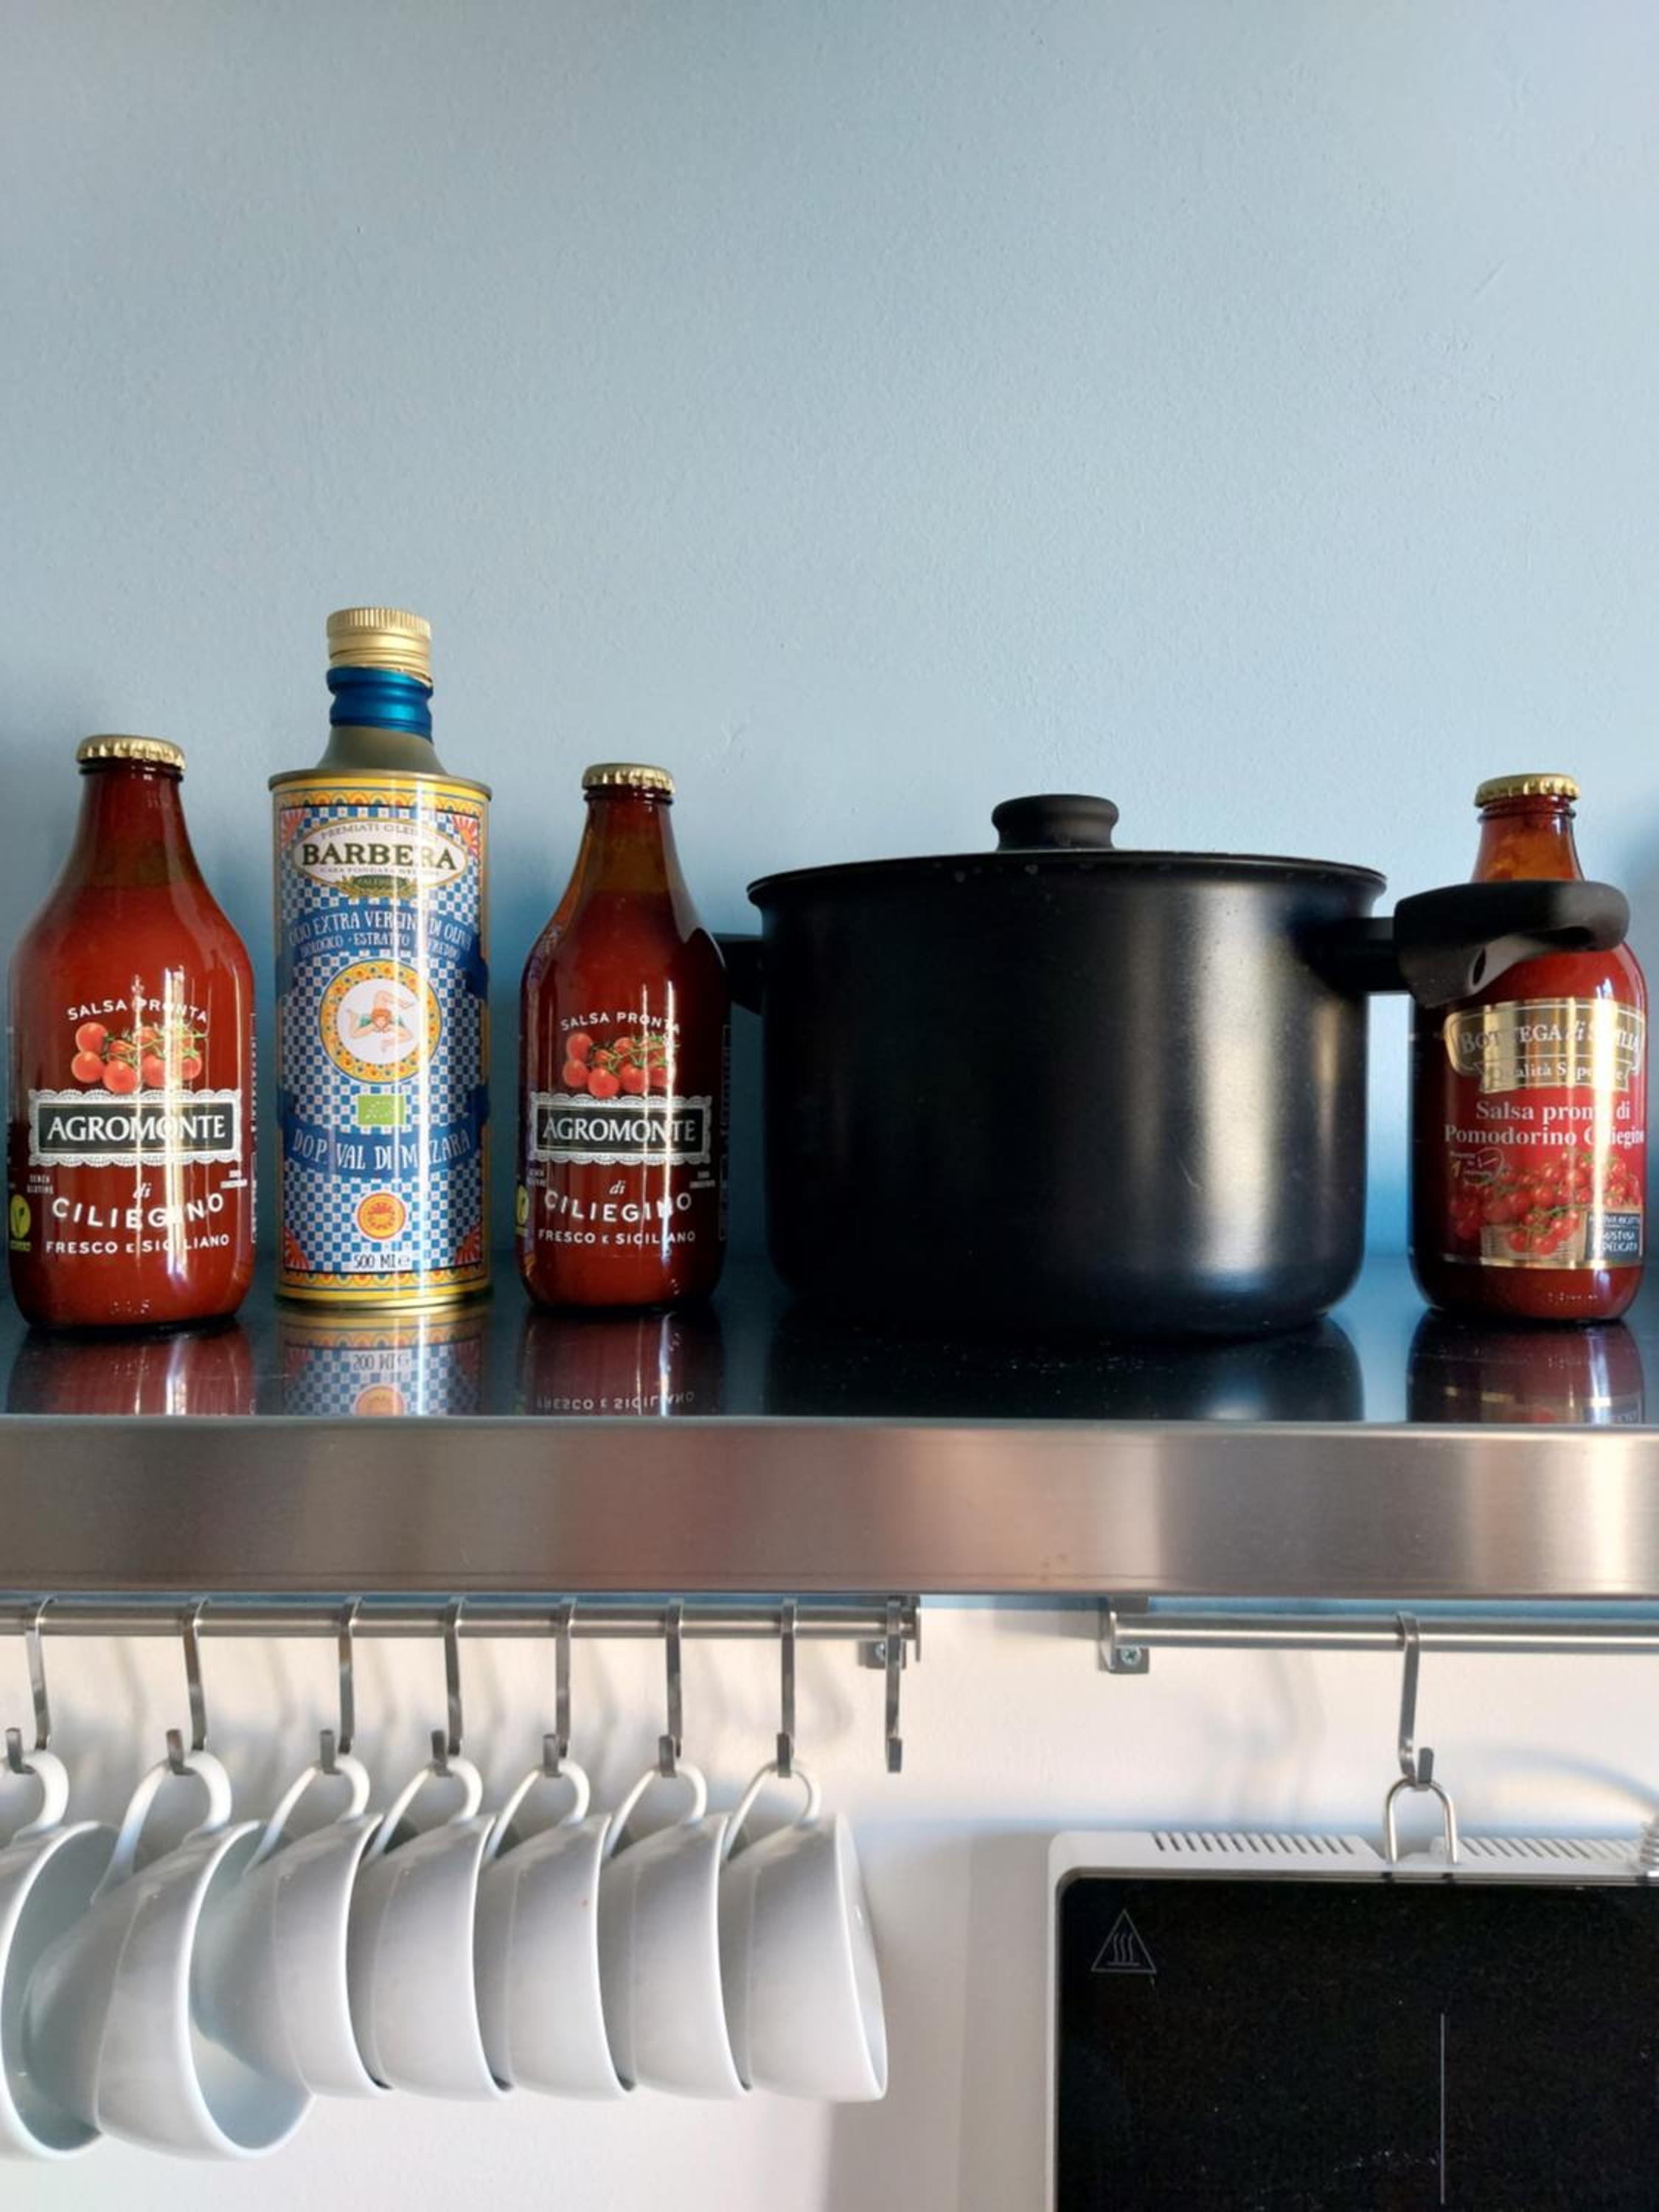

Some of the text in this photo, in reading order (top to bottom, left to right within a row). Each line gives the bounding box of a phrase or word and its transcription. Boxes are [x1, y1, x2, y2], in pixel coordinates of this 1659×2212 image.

[302, 842, 457, 870] BARBERA
[313, 911, 361, 936] EXTRA
[429, 917, 442, 933] DI
[67, 998, 128, 1021] SALSA
[560, 1012, 611, 1031] SALSA
[1475, 1100, 1534, 1119] Salsa
[1615, 1101, 1631, 1119] di
[47, 1116, 226, 1141] AGROMONTE
[543, 1117, 696, 1142] AGROMONTE
[1444, 1124, 1577, 1147] Pomodorino
[337, 1144, 366, 1169] VAL
[375, 1145, 392, 1170] DI
[609, 1180, 626, 1194] di
[544, 1189, 692, 1222] CILIEGINO
[46, 1241, 118, 1253] FRESCO
[538, 1229, 596, 1244] FRESCO
[354, 1253, 375, 1269] 500
